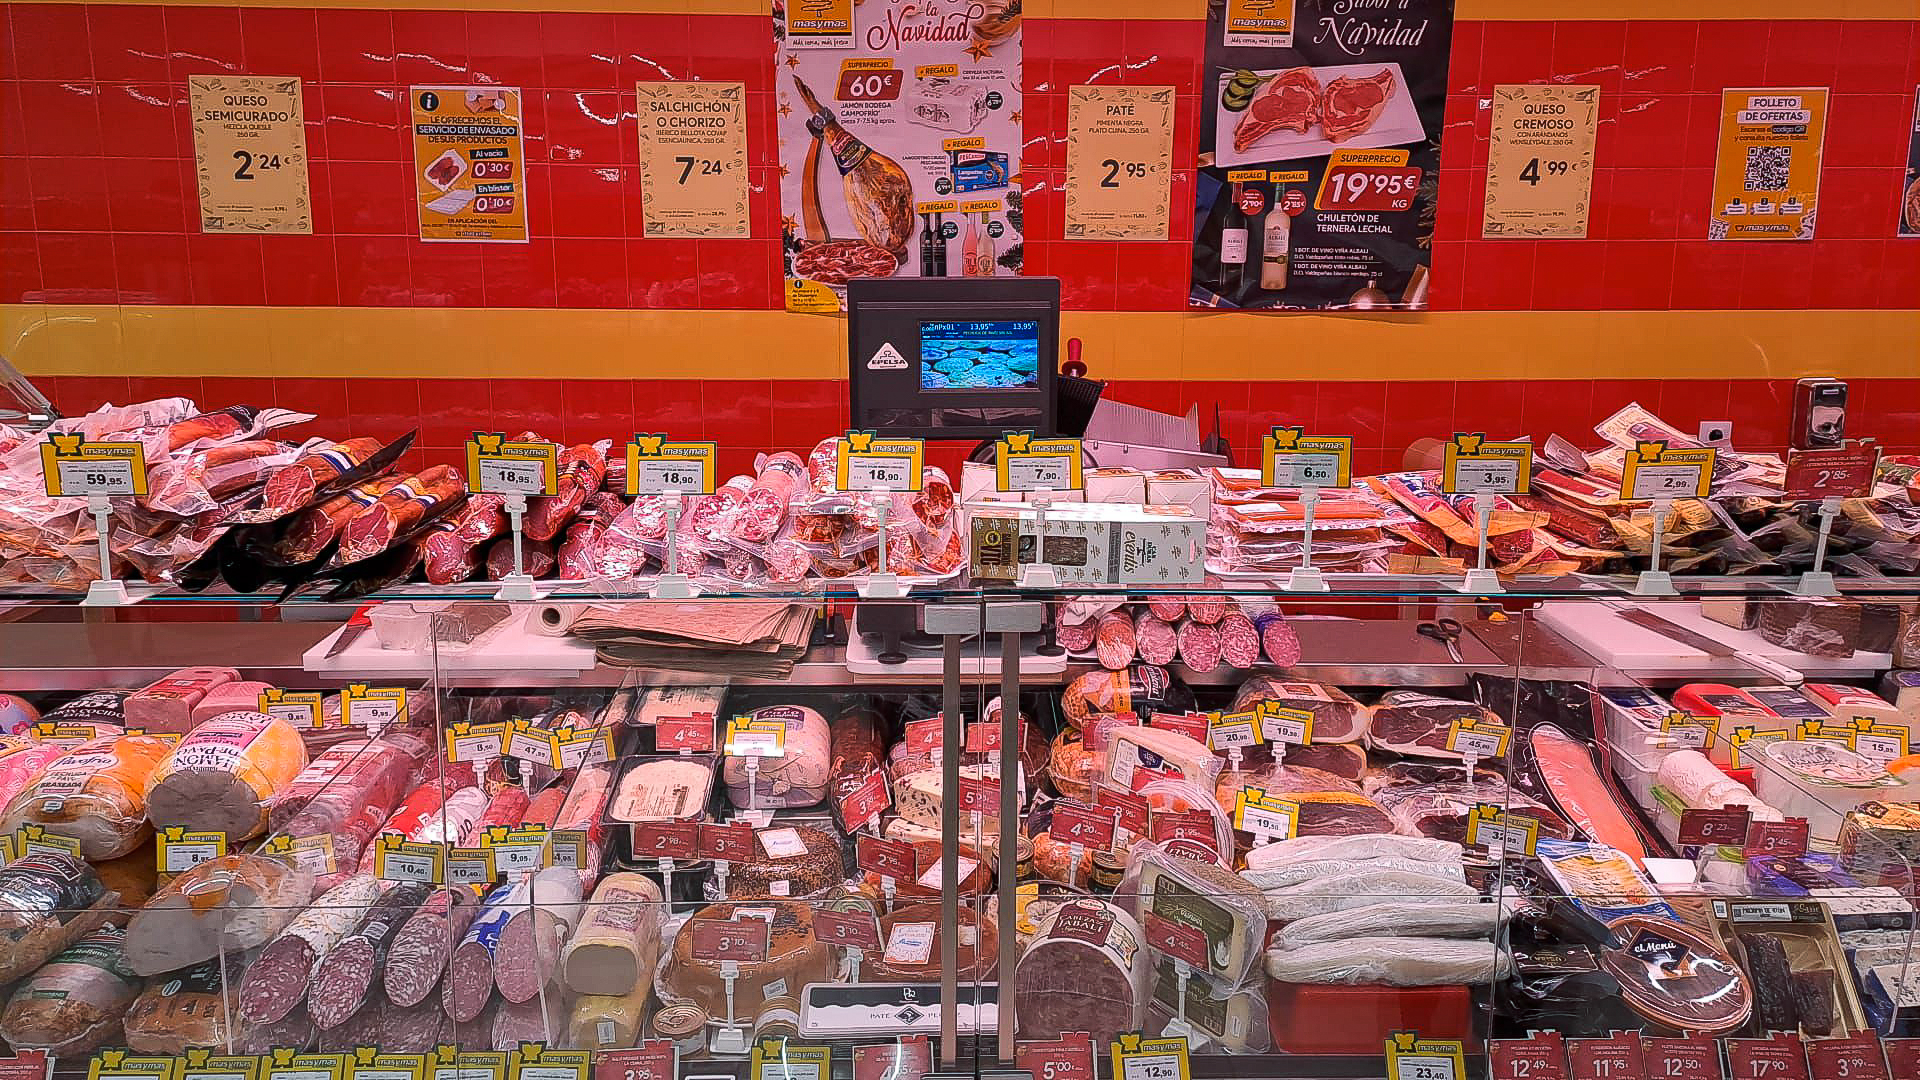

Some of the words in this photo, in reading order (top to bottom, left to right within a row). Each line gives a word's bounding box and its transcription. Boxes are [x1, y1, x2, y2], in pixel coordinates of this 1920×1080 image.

[925, 1, 938, 17] la
[792, 20, 847, 31] masymas
[867, 4, 984, 50] Navidad
[1232, 18, 1287, 29] masymas
[1314, 18, 1428, 55] Navidad
[848, 60, 889, 69] SUPERPRECIO
[926, 67, 955, 76] REGALO
[851, 76, 894, 98] 60€
[224, 95, 267, 107] QUESO
[650, 100, 731, 112] SALCHICHÓN
[1754, 98, 1797, 107] FOLLETO
[1106, 103, 1135, 116] PATÉ
[1524, 104, 1565, 114] QUESO
[204, 110, 288, 122] SEMICURADO
[1745, 111, 1758, 120] DE
[1759, 112, 1803, 121] OFERTAS
[656, 117, 667, 127] O
[669, 117, 726, 127] CHORIZO
[1513, 119, 1574, 129] CREMOSO
[418, 126, 456, 134] SERVICIO
[470, 127, 515, 135] ENVASADO
[456, 136, 507, 144] PRODUCTOS
[953, 140, 981, 148] REGALO
[1341, 154, 1401, 163] SUPERPRECIO
[1331, 172, 1416, 203] 19'95€
[1391, 199, 1408, 208] KG
[1316, 213, 1366, 222] CHULETÓN
[1367, 214, 1379, 222] DE
[1316, 224, 1356, 232] TERNERA
[1357, 225, 1393, 233] LECHAL
